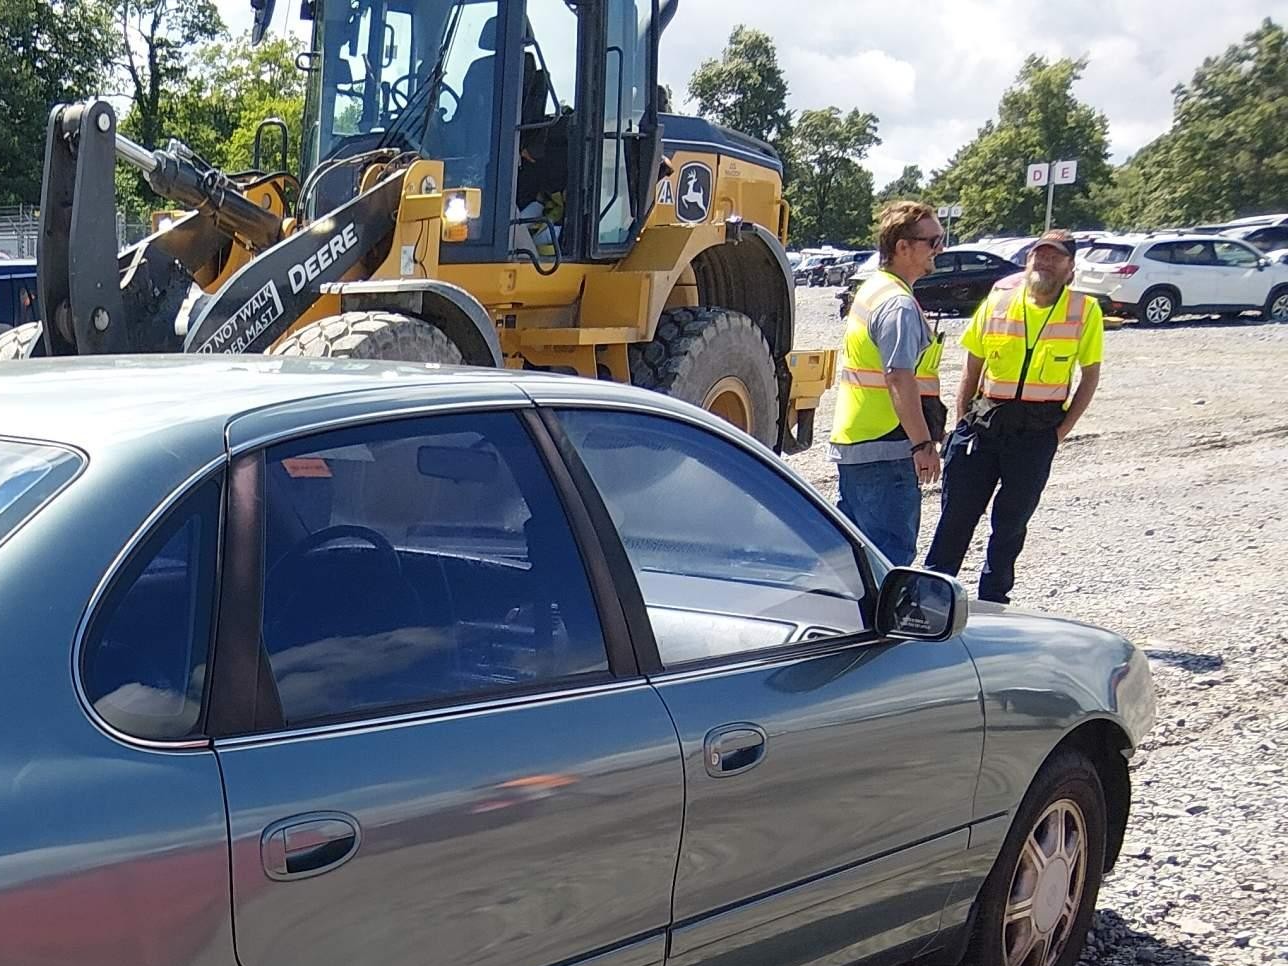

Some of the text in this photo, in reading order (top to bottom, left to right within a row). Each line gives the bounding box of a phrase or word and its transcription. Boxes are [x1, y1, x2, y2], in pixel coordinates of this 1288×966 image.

[1032, 169, 1043, 182] D
[1060, 166, 1070, 179] E
[288, 222, 359, 294] DEERE
[214, 316, 239, 349] NOT
[239, 284, 273, 323] WALK
[245, 306, 273, 342] MAST
